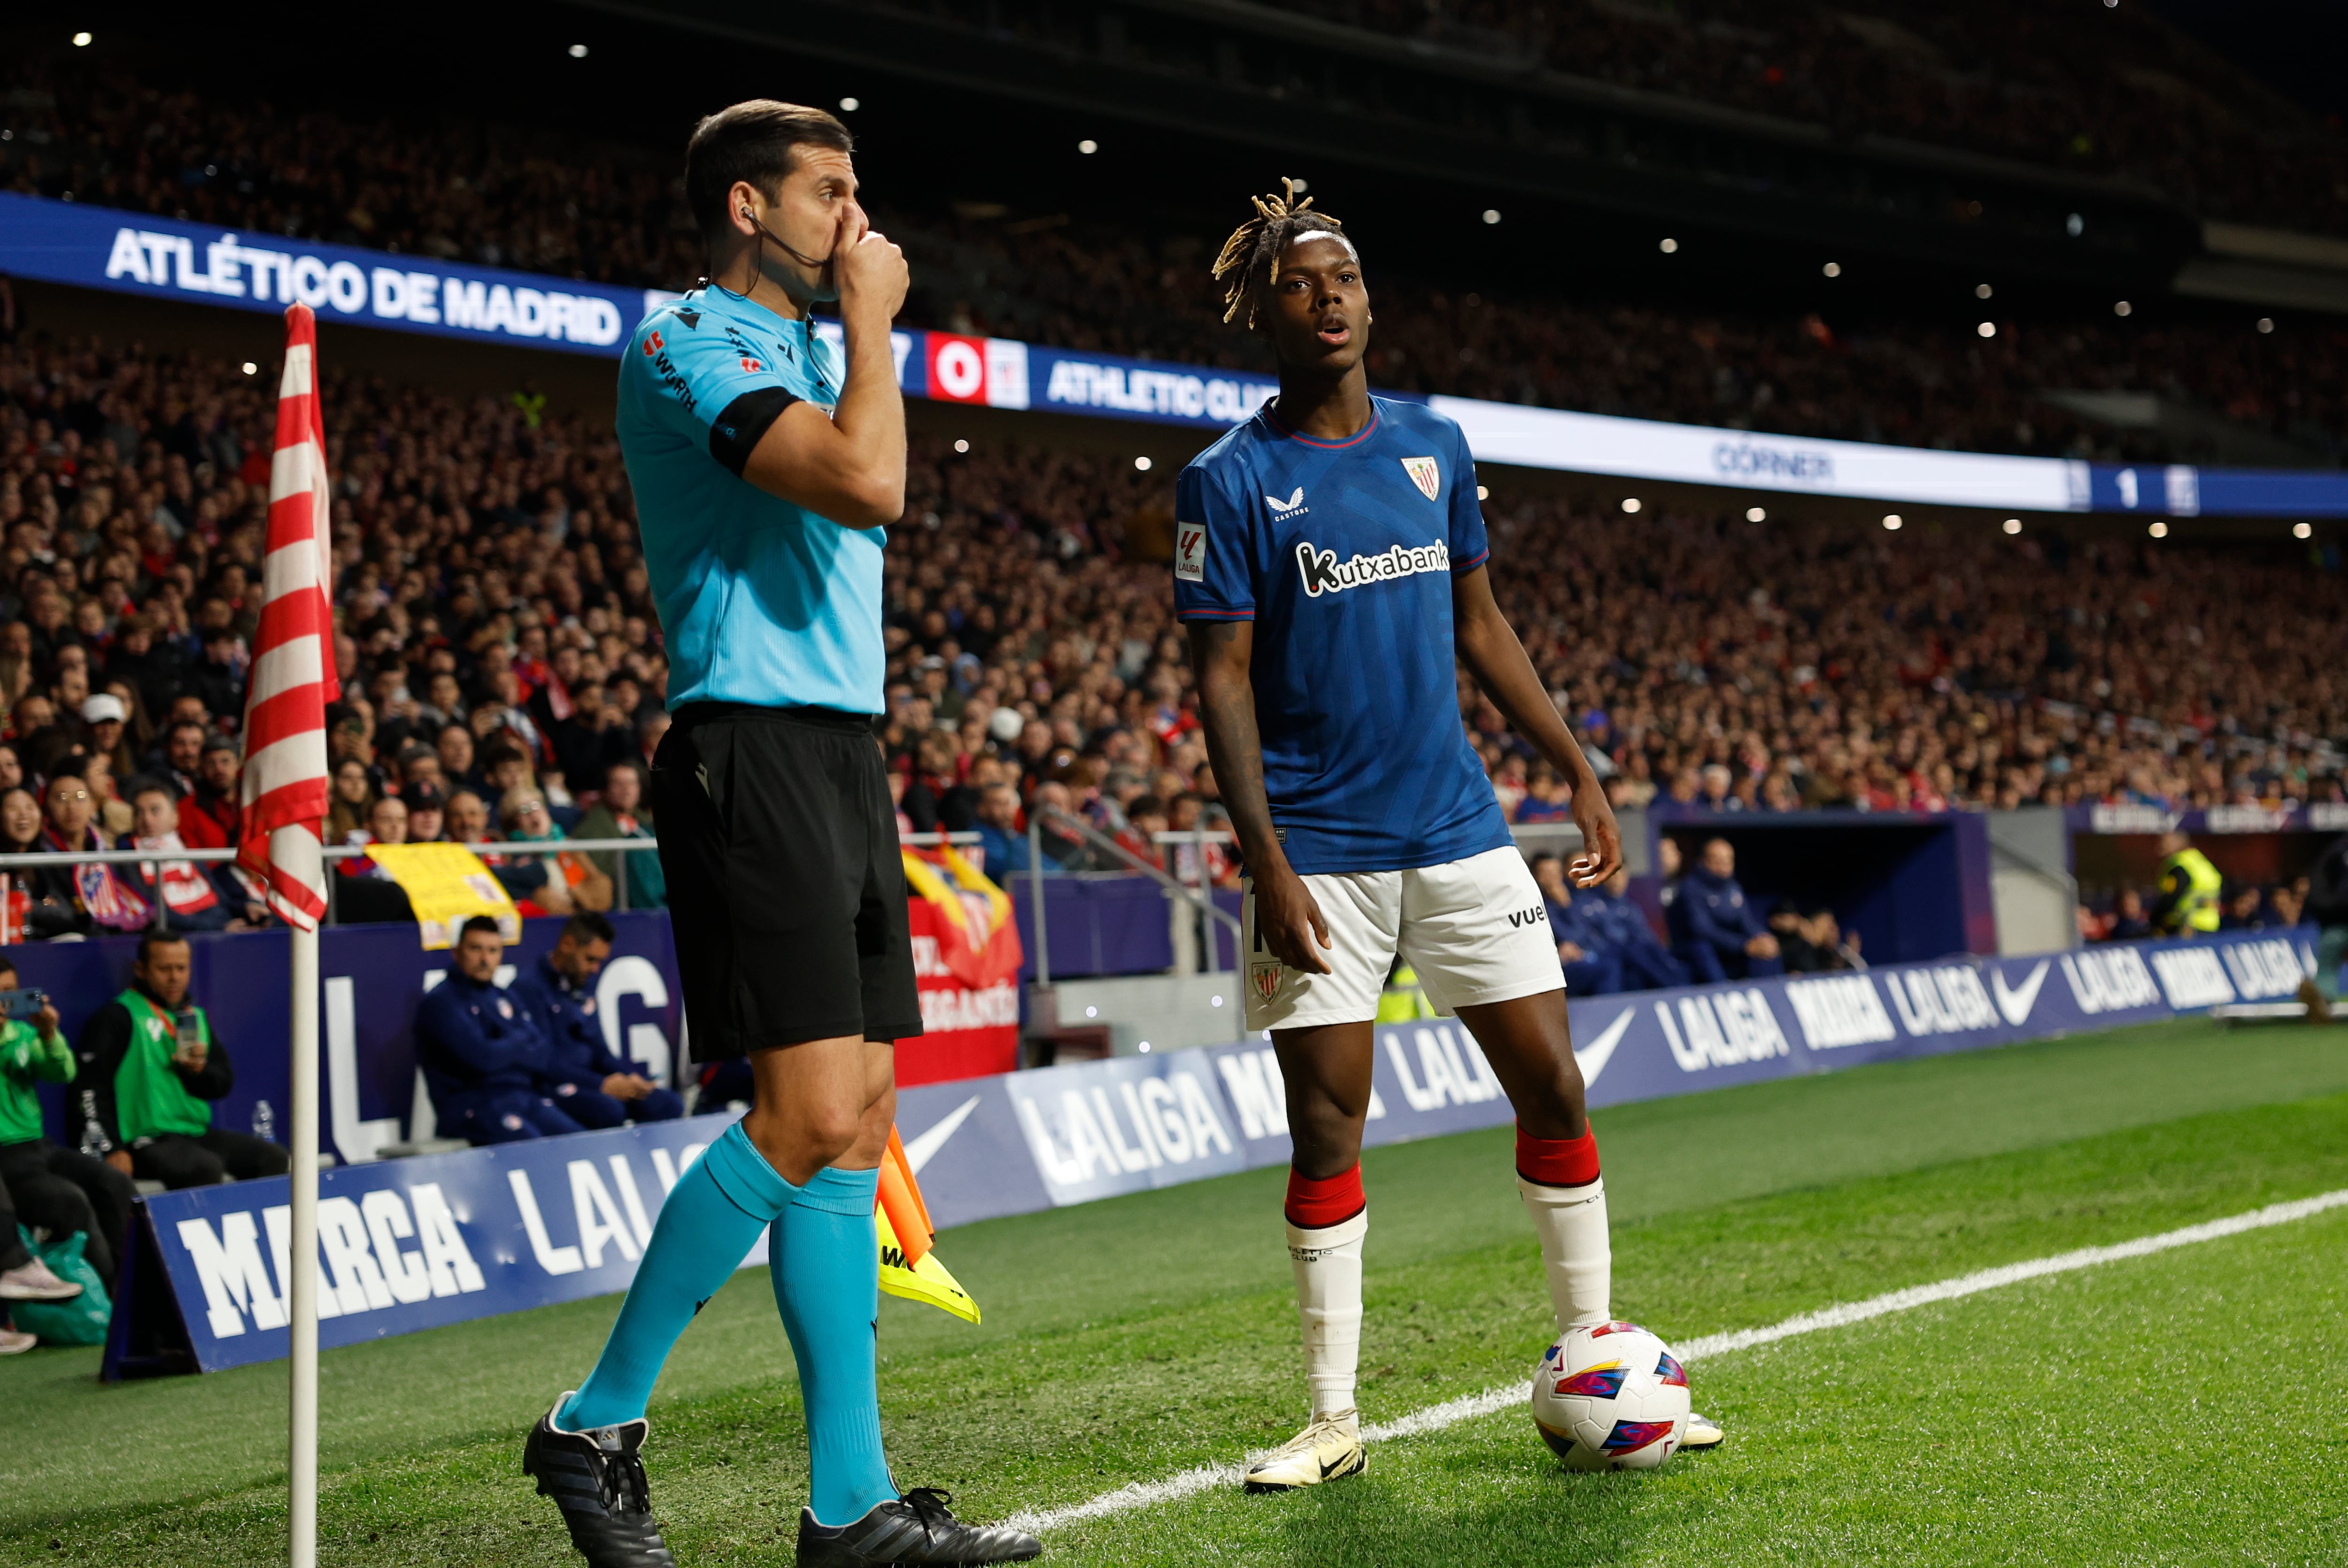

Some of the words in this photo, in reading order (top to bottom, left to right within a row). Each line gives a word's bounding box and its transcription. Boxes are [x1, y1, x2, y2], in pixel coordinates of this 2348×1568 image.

[106, 227, 367, 314] ATLÉTICO
[372, 267, 441, 325] DE
[444, 277, 622, 346] MADRID
[656, 353, 697, 414] WÜRTH
[936, 341, 982, 398] 0
[1047, 359, 1204, 418] ATHLETIC
[1274, 507, 1309, 522] CASTORE
[2116, 469, 2139, 509] 1
[1179, 563, 1200, 573] LALIGA
[1300, 543, 1449, 594] Kutxabank
[1654, 988, 1789, 1072] LALIGA
[1383, 1024, 1508, 1112] LALI
[1024, 1071, 1232, 1186] LALIGA
[507, 1143, 707, 1276] LALI
[176, 1182, 486, 1339] MARCA
